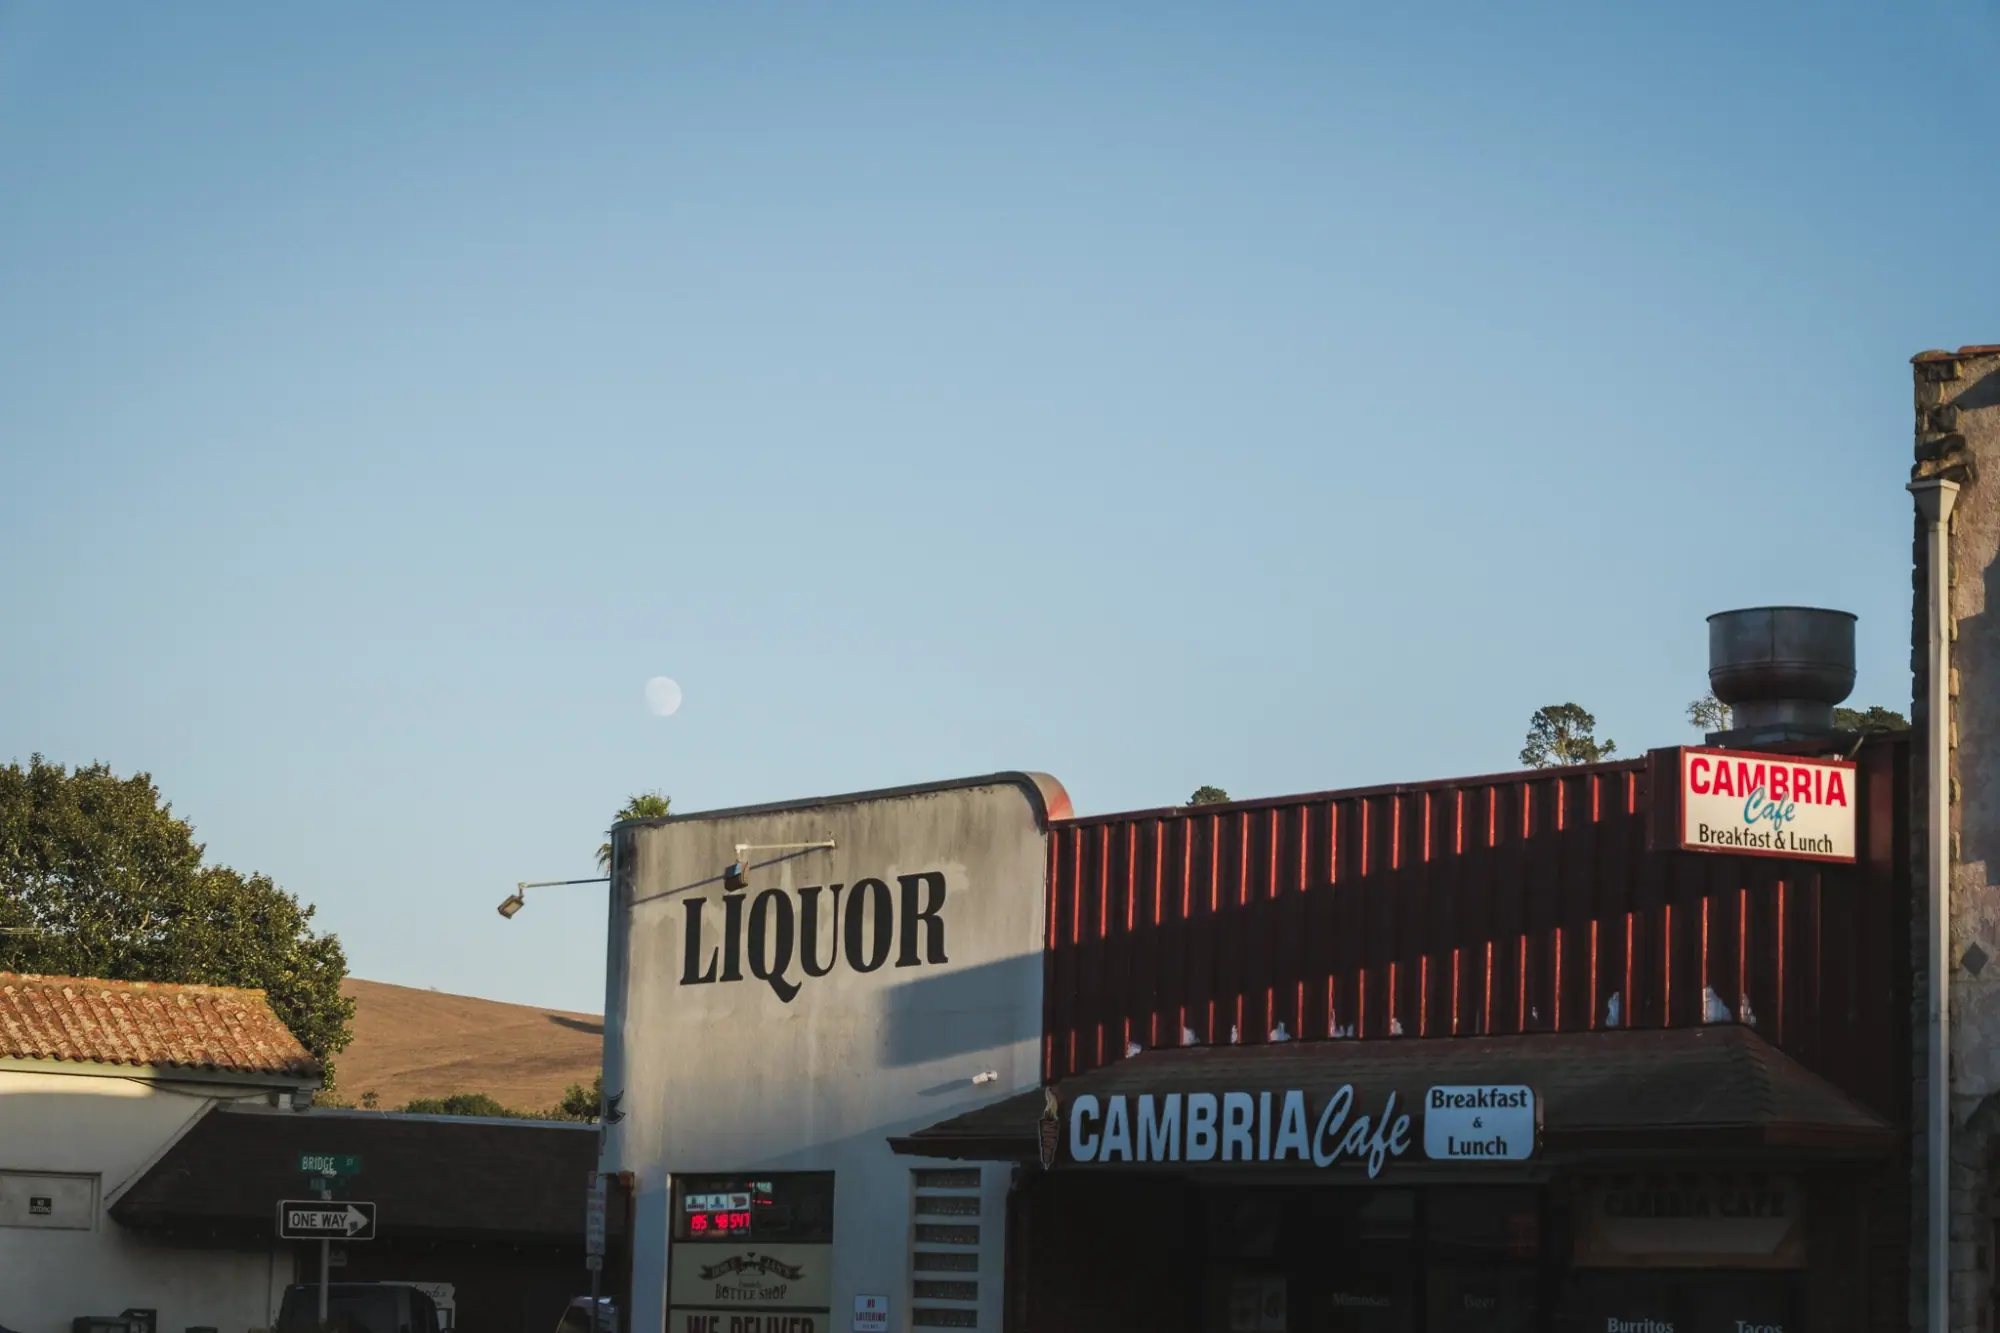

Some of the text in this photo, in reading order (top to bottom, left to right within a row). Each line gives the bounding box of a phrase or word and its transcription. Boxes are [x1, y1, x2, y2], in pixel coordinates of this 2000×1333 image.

[1690, 757, 1848, 807] CAMBRIA
[1743, 787, 1795, 831] Cafe
[1699, 823, 1833, 854] Breakfast & Lunch
[680, 871, 949, 1003] LIQUOR
[1431, 1088, 1528, 1109] Breakfast
[1069, 1084, 1411, 1179] CAMBRIA Cafe
[1472, 1116, 1483, 1129] &
[1447, 1134, 1507, 1157] Lunch
[302, 1156, 336, 1171] BRIDGE
[292, 1213, 348, 1228] ONE WAY
[715, 1283, 756, 1300] BOTTLE
[759, 1284, 788, 1300] SHOP
[1607, 1317, 1675, 1333] Burritos
[1735, 1320, 1784, 1333] Tacos
